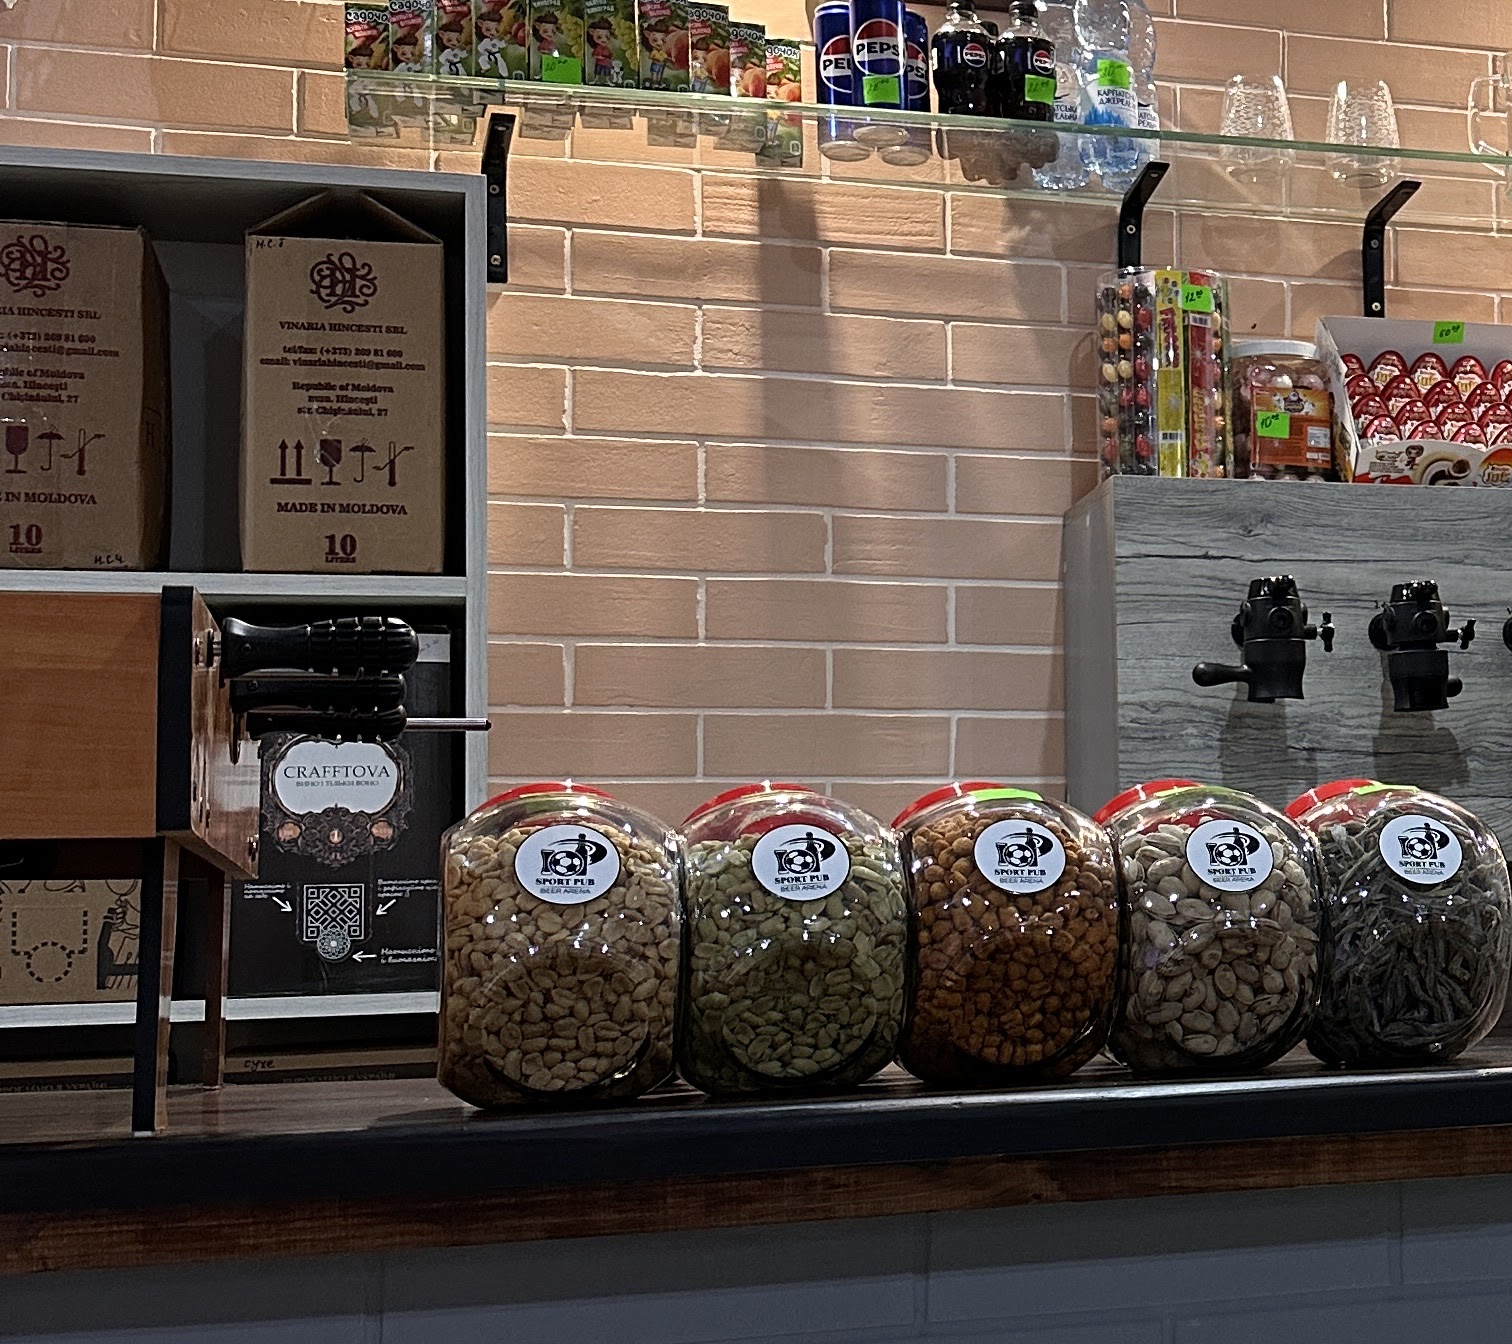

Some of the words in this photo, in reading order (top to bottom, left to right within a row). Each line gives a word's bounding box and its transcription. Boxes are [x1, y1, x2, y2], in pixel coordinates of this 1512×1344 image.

[857, 42, 900, 56] PEPS
[279, 321, 326, 332] VINARIA
[24, 492, 98, 505] MOLDOVA
[277, 502, 318, 513] MADE
[320, 503, 336, 514] IN
[339, 503, 408, 515] MOLDOVA
[9, 524, 42, 546] 10
[325, 534, 357, 557] 10
[284, 765, 391, 778] CRAFFTOVA
[536, 877, 571, 885] SPORT
[775, 875, 807, 884] SPORT
[810, 874, 829, 882] PUB
